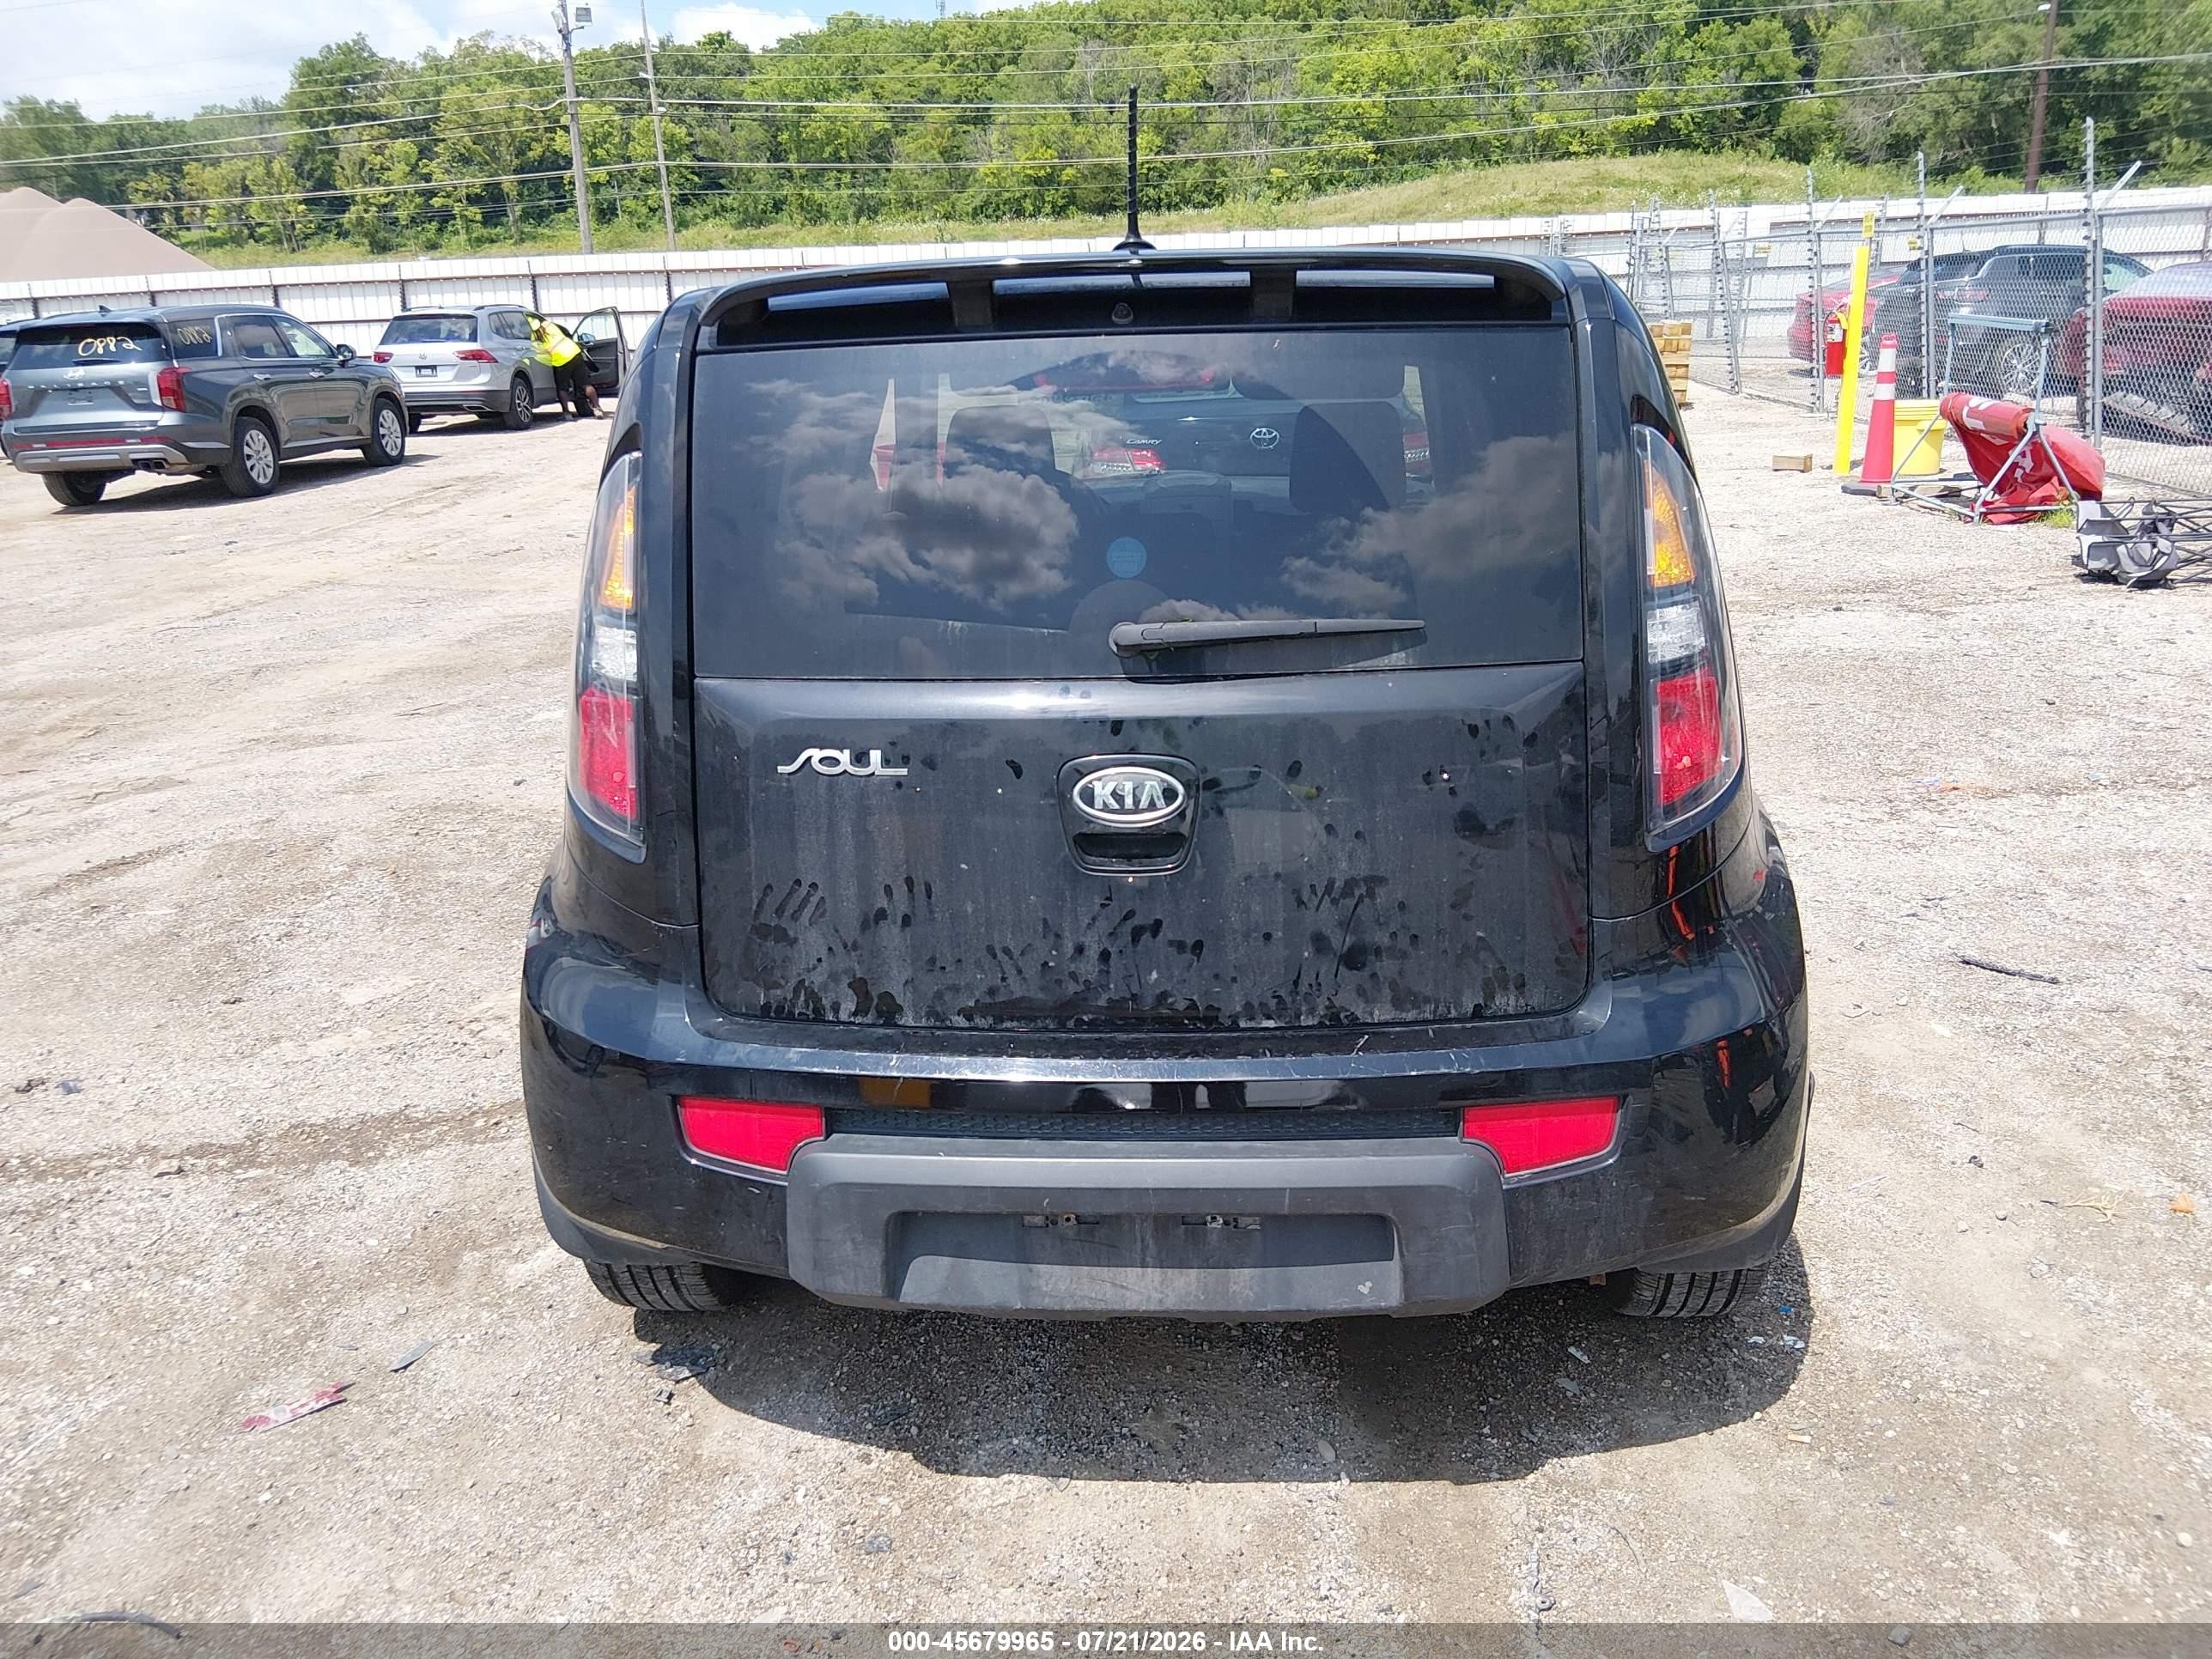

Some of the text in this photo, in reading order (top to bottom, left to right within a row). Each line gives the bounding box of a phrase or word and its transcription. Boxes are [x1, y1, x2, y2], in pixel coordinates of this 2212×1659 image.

[77, 336, 143, 356] 0882
[177, 326, 213, 345] 0882
[776, 747, 908, 776] SOUL
[1091, 780, 1168, 811] KIA
